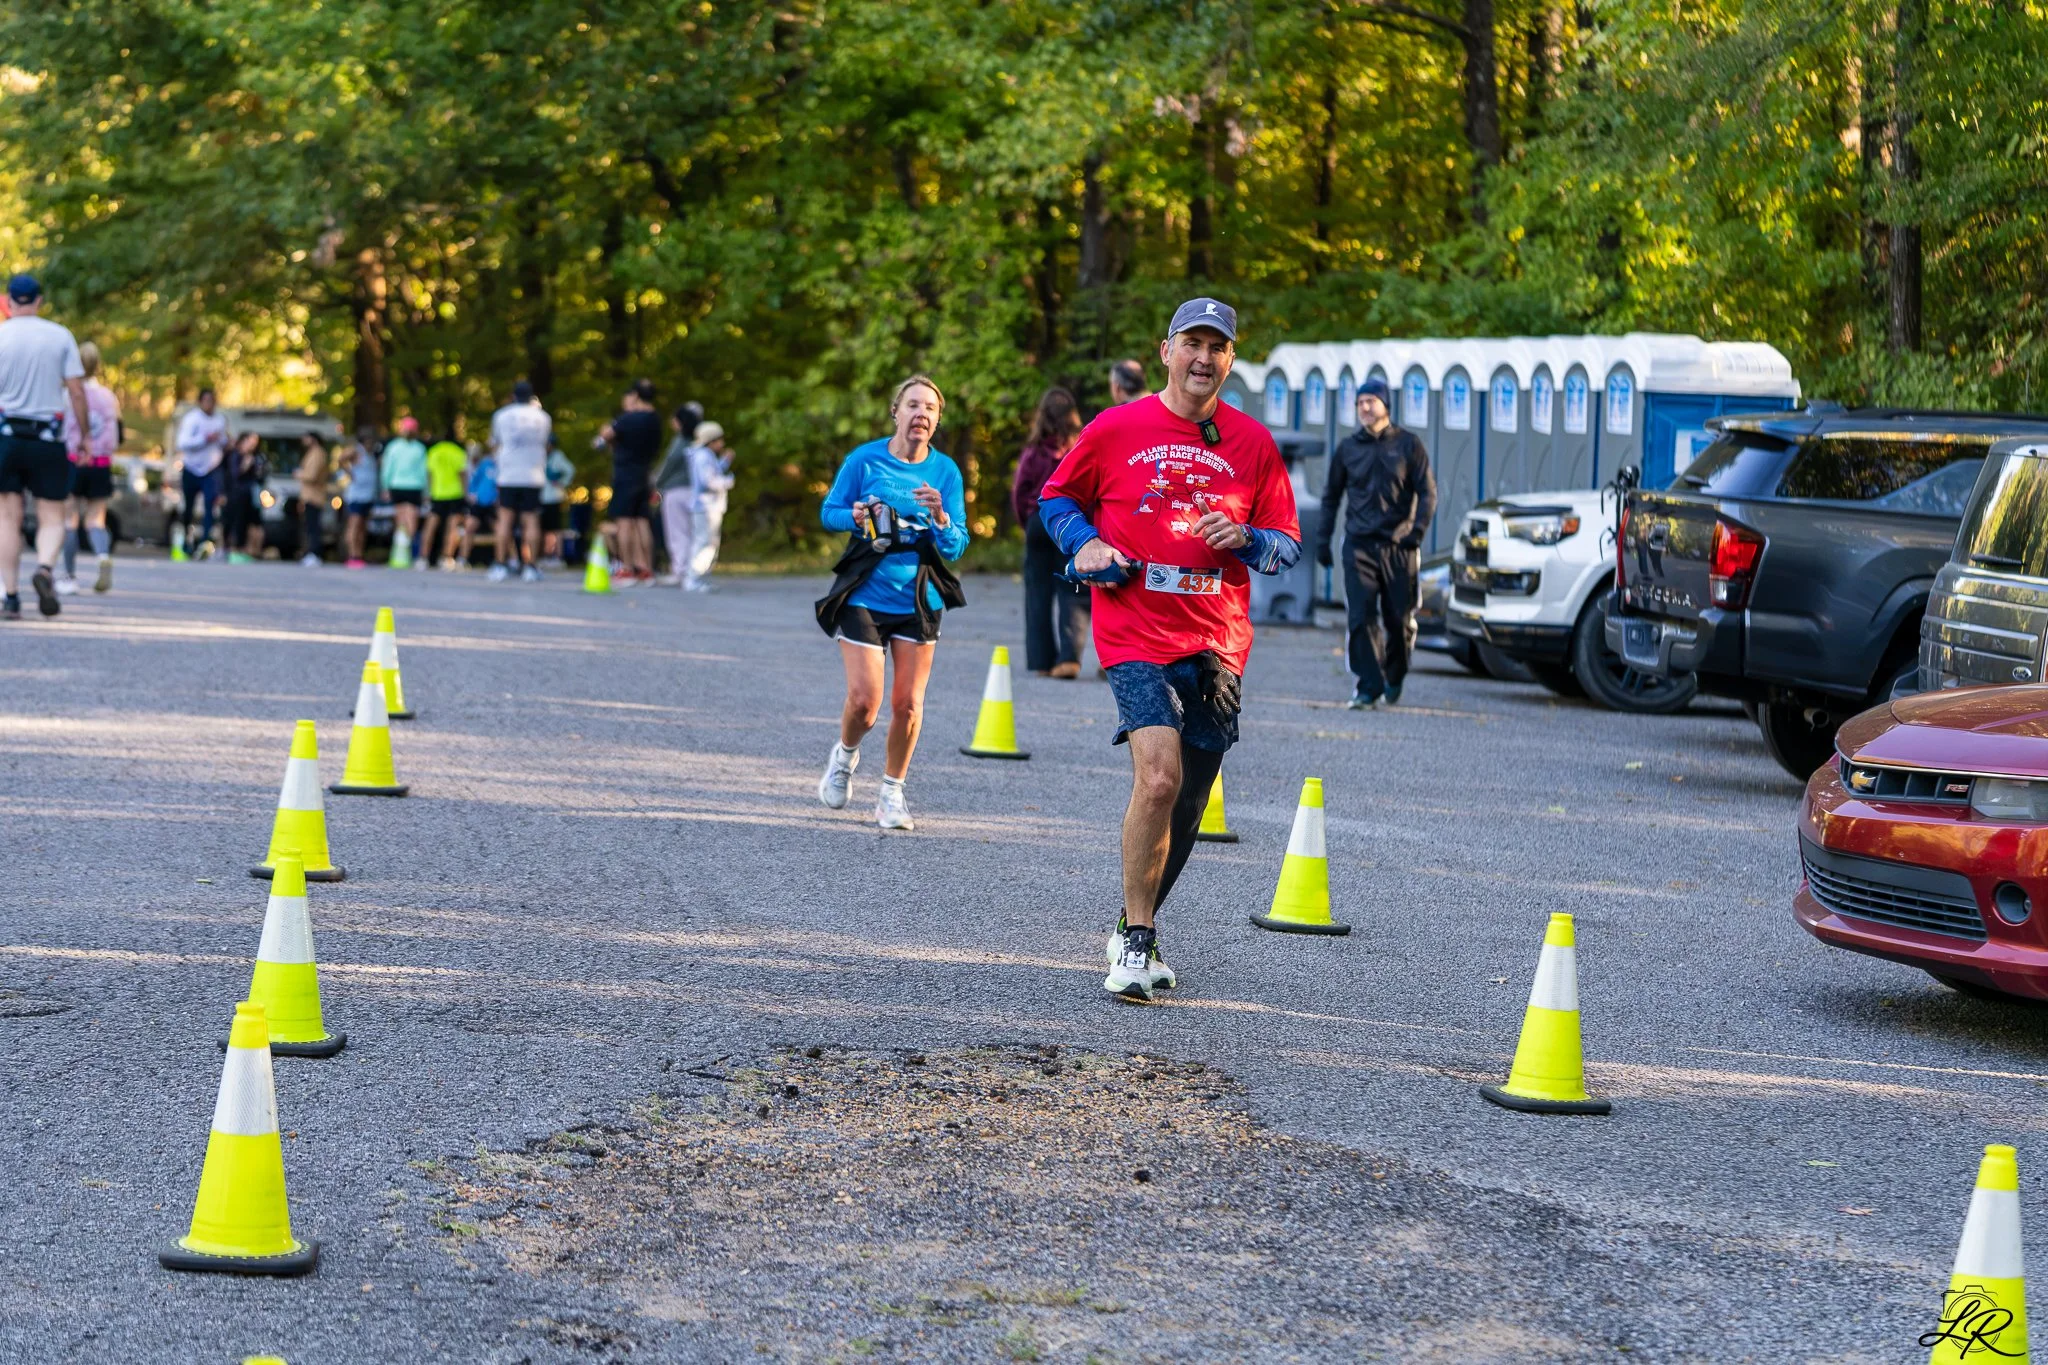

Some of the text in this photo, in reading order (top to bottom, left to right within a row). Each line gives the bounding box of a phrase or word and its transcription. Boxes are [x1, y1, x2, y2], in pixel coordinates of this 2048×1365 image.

[1127, 450, 1146, 466] 2024
[1147, 444, 1168, 455] LANE
[1170, 444, 1201, 455] PURSER
[1202, 449, 1236, 479] MEMORIAL
[1142, 451, 1167, 464] ROAD
[1169, 451, 1193, 460] RACE
[1194, 454, 1224, 473] SERIES
[1177, 575, 1214, 593] 432
[1944, 783, 1969, 792] RS
